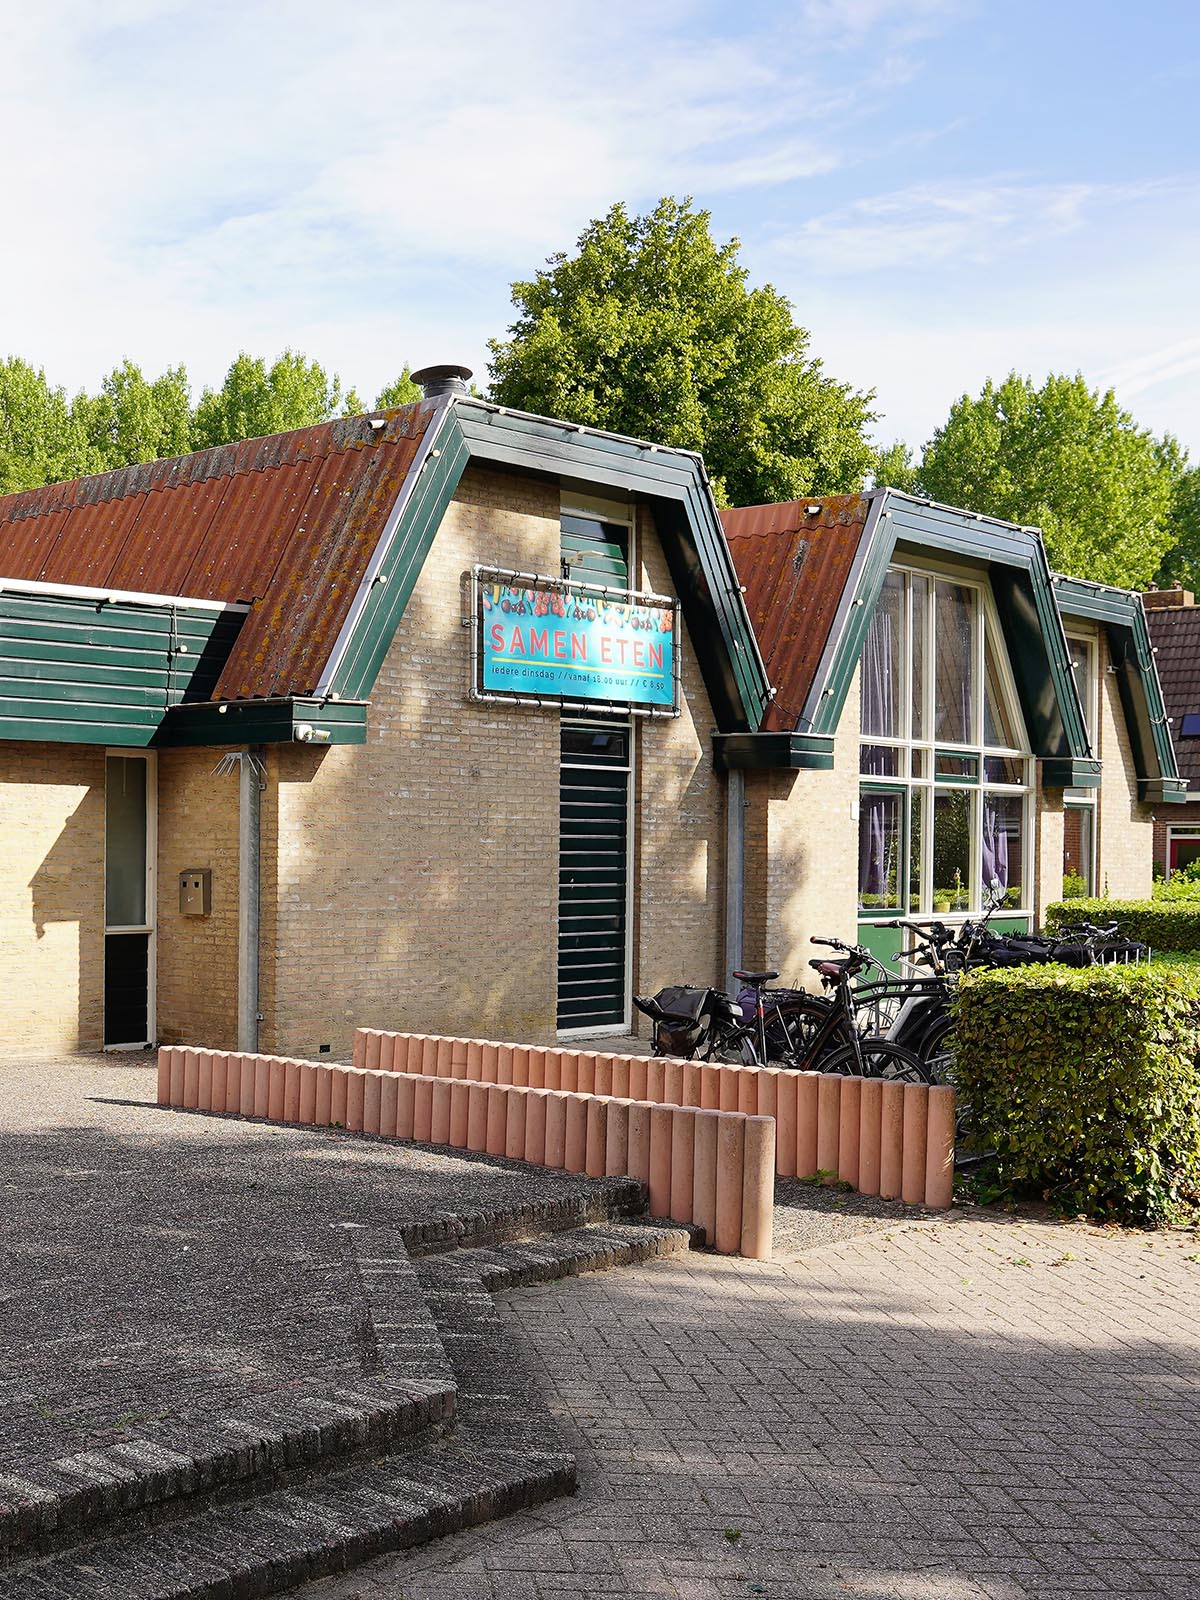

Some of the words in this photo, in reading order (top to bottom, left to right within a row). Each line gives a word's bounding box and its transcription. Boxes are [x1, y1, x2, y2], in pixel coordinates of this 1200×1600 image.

[491, 624, 586, 660] SAMEN
[601, 636, 663, 669] ETEN
[492, 665, 519, 676] iedere
[522, 668, 555, 680] dinsdag
